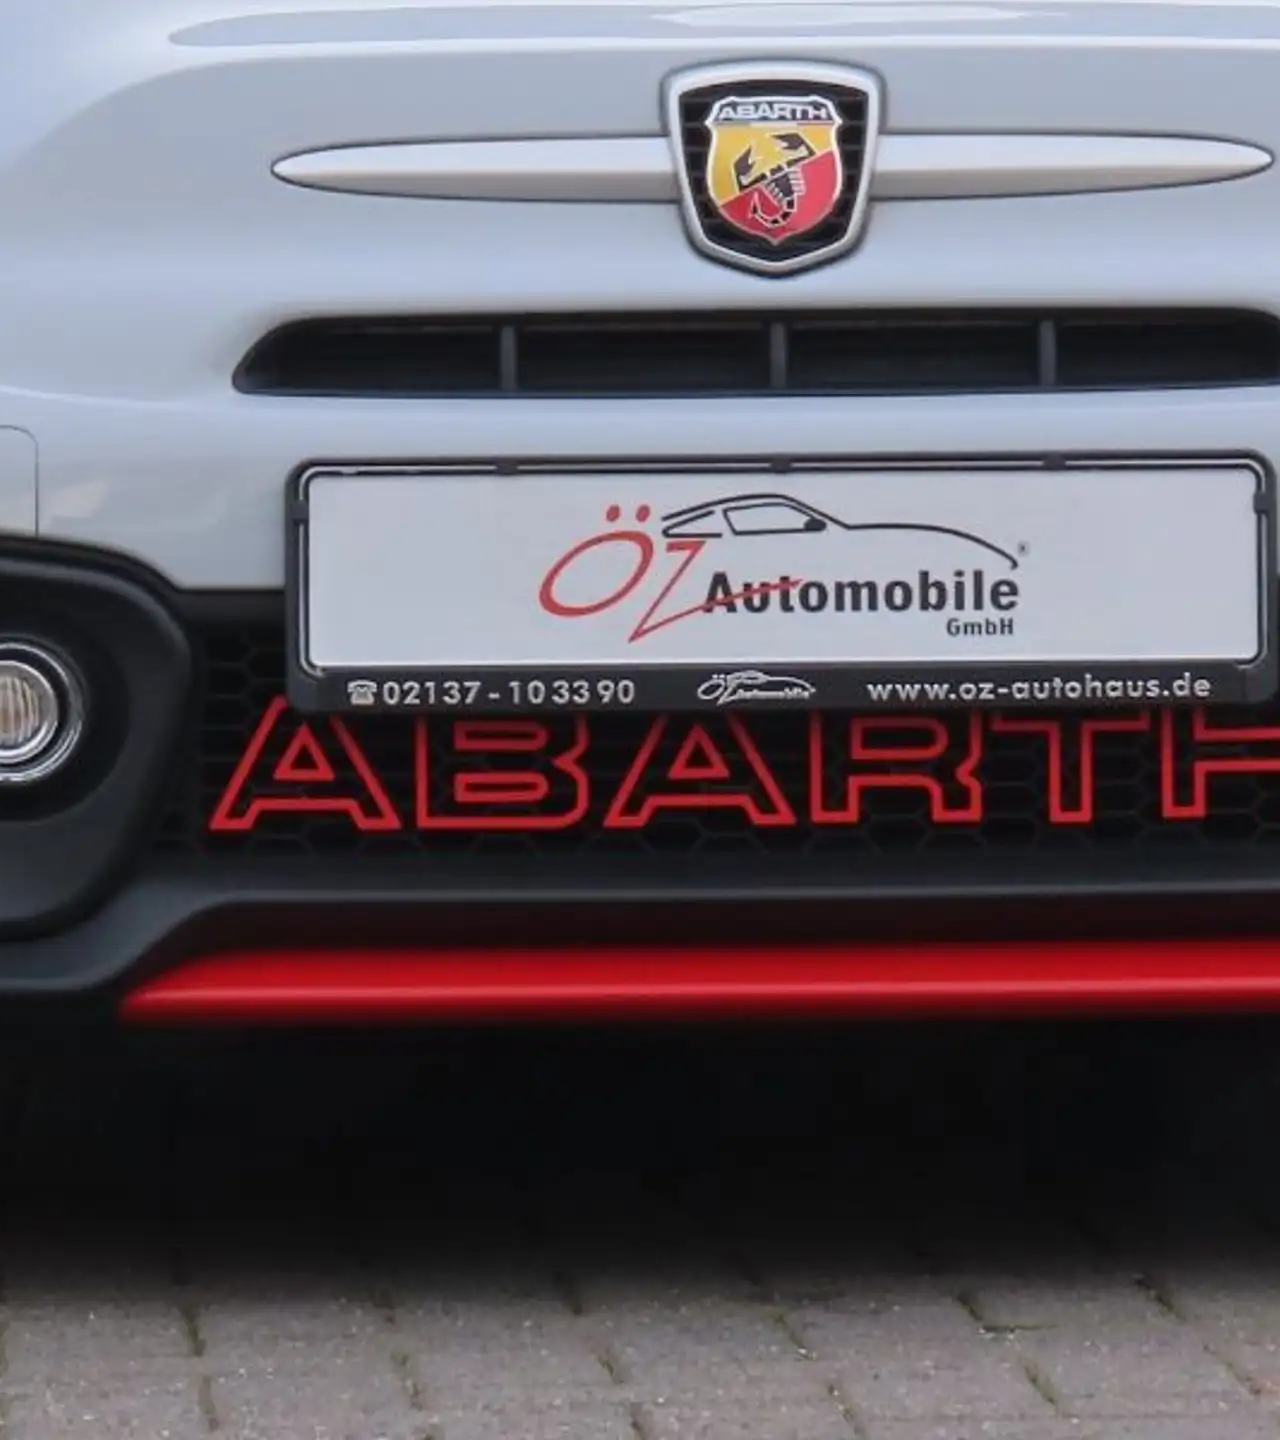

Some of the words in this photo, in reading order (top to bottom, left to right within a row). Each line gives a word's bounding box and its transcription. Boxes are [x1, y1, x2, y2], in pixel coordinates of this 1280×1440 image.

[719, 103, 828, 120] ABARTH
[538, 504, 710, 643] ÖZ
[704, 570, 1019, 615] Automobile
[946, 618, 1015, 637] GmbH
[866, 672, 1212, 702] www.oz-autohaus.de
